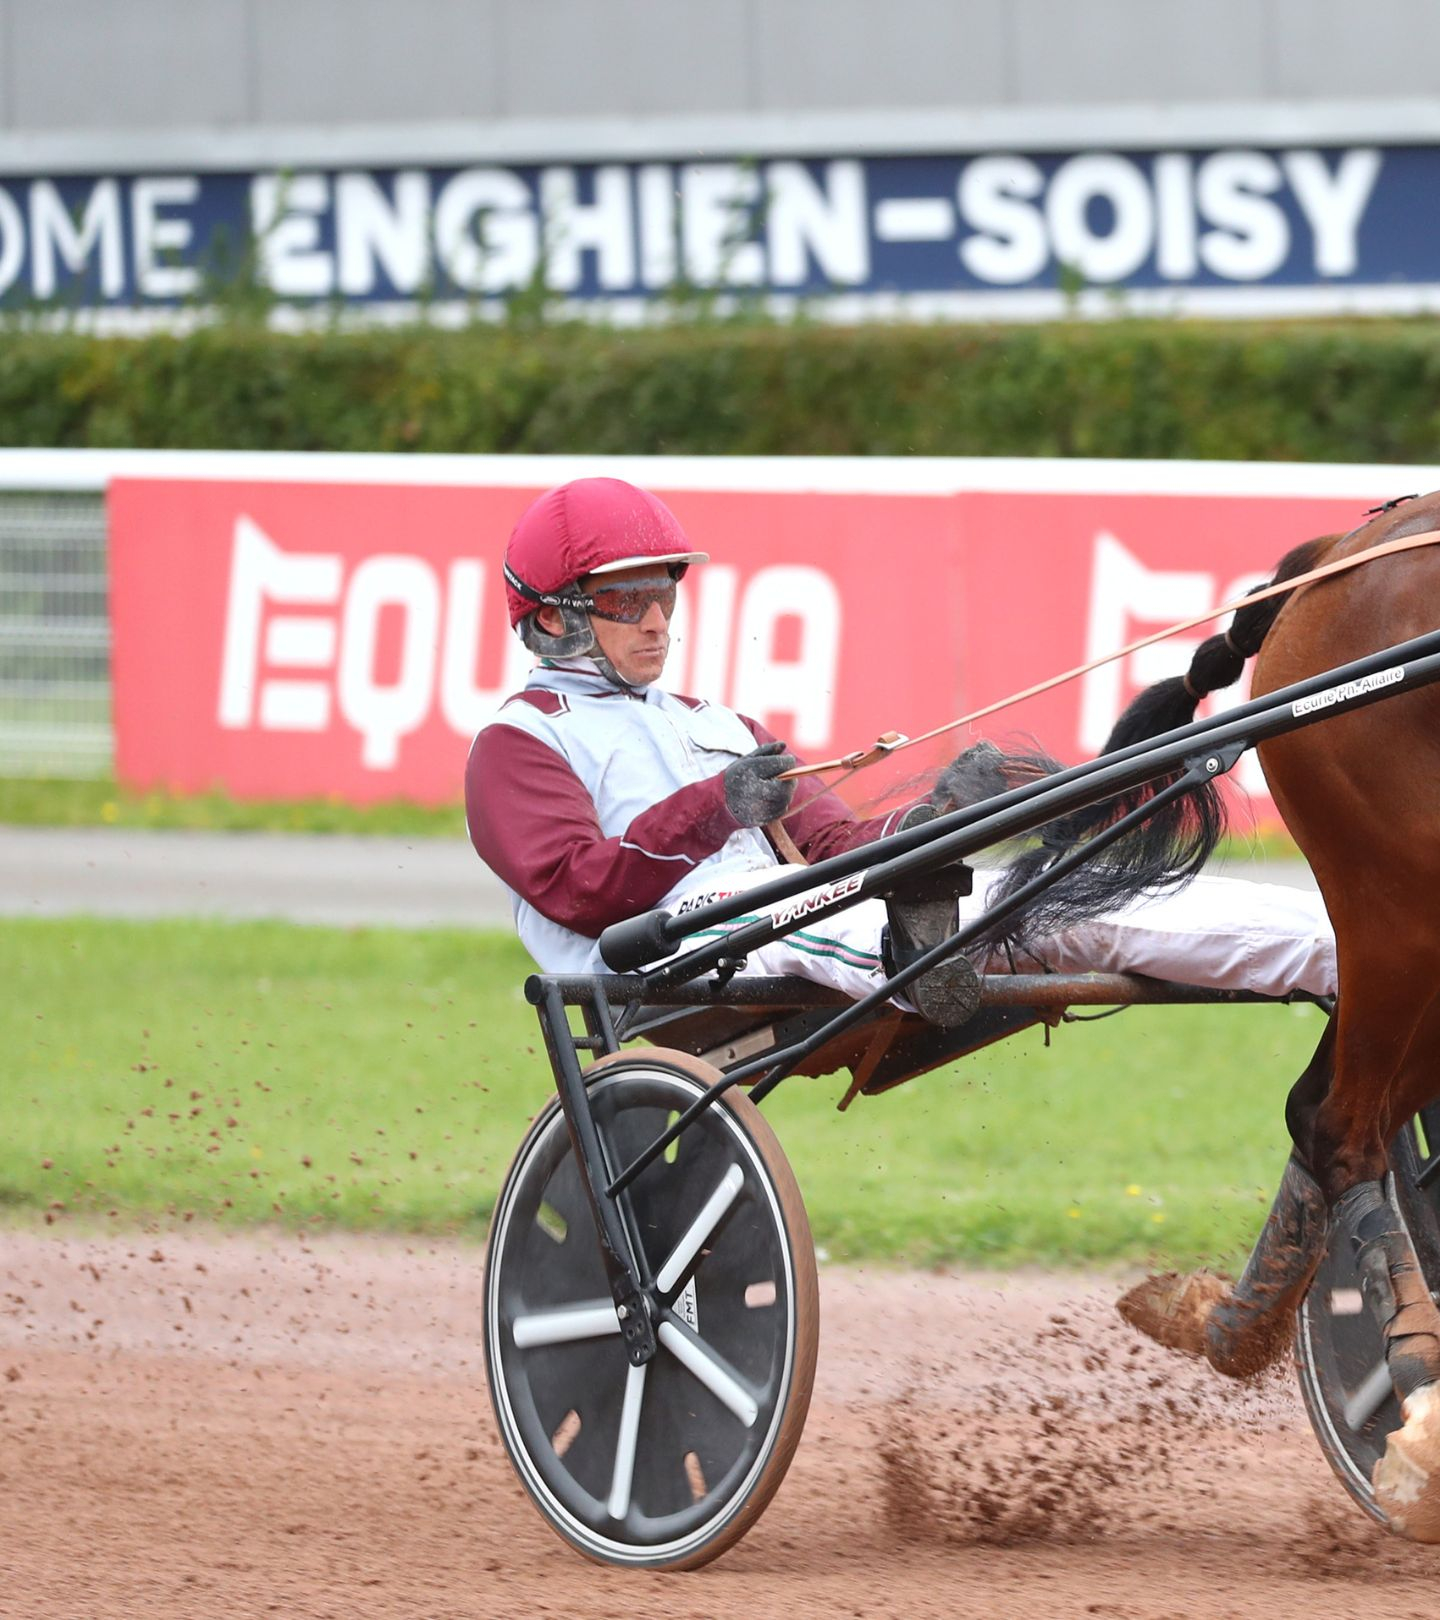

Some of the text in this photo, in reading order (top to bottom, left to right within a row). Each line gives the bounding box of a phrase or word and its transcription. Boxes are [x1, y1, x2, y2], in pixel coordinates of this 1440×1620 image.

[0, 148, 1383, 300] ME ENGHIEN-SOISY
[1294, 687, 1336, 715] Ecurie
[772, 875, 862, 926] YANKEE
[685, 1290, 695, 1325] FMT
